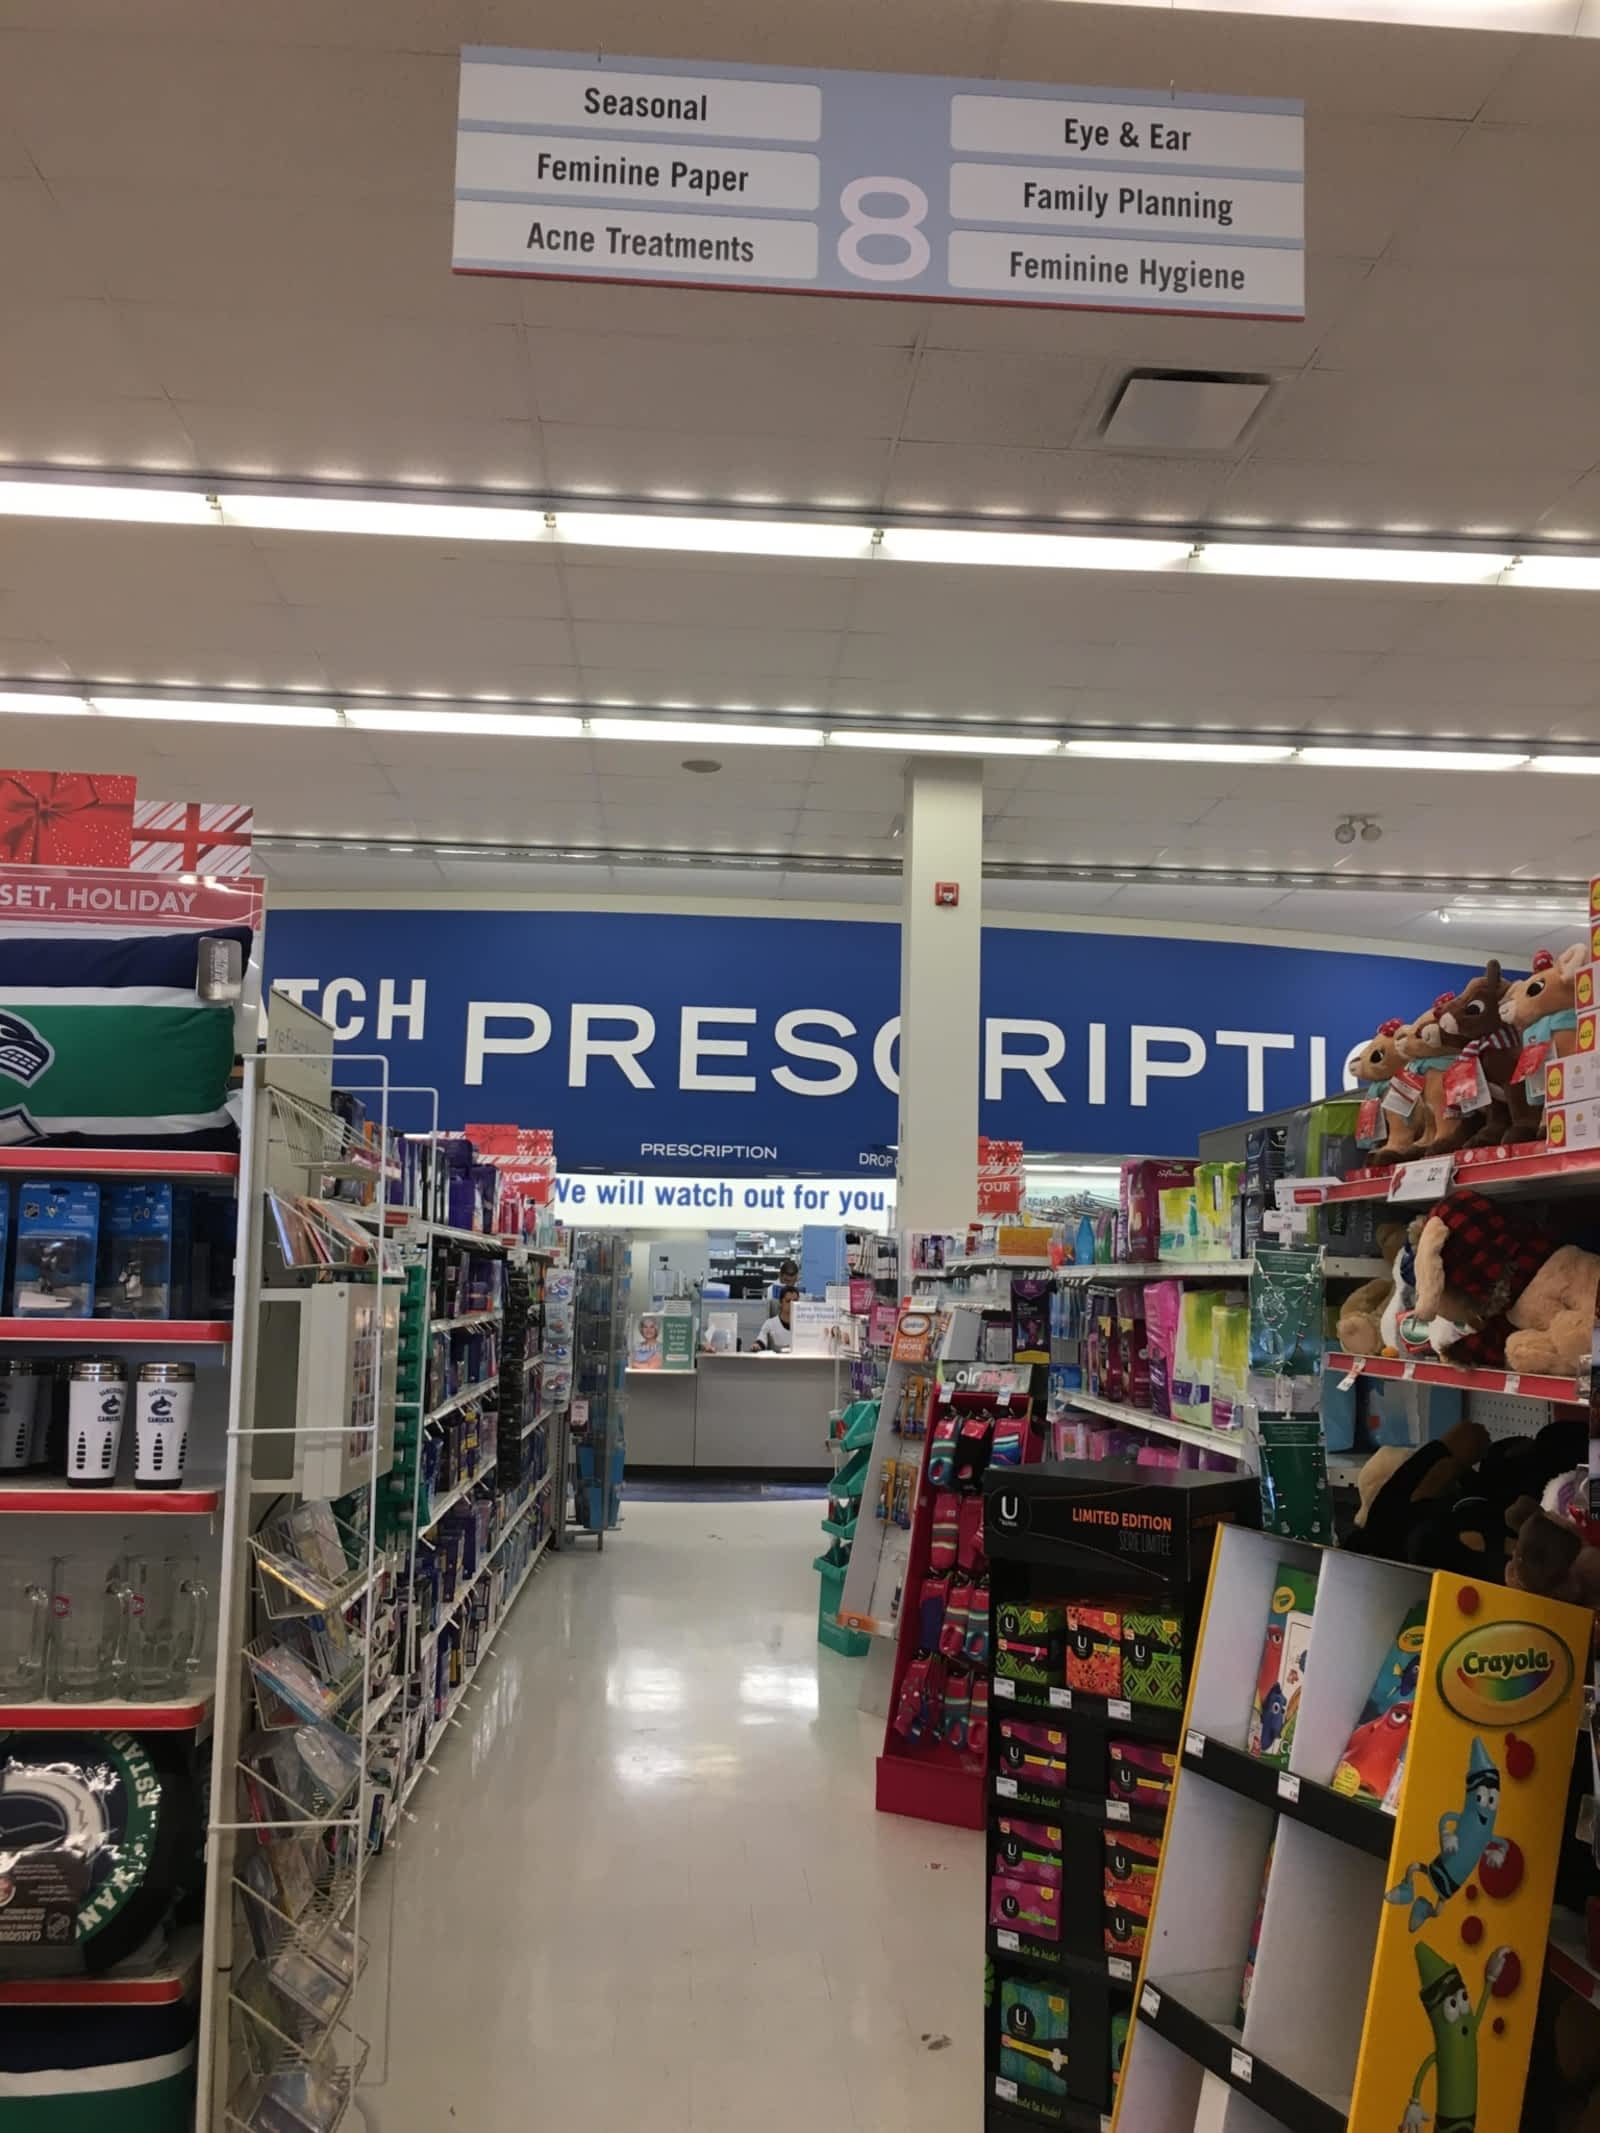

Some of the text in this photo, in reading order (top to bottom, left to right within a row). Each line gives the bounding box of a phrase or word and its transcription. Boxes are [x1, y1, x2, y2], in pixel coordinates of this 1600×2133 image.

[583, 88, 709, 123] Seasonal
[1064, 118, 1193, 153] Eye & Ear
[536, 153, 750, 199] Feminine Paper
[1023, 182, 1234, 228] Family Planning
[526, 222, 755, 264] Acne Treatments
[837, 175, 932, 282] 8
[1009, 251, 1246, 294] Feminine Hygiene
[0, 884, 198, 913] SET, HOLIDAY
[257, 977, 427, 1041] TCH
[463, 1001, 1371, 1113] PRESRIPTI
[640, 1143, 777, 1159] PRESCRIPTION
[859, 1153, 893, 1167] DROP
[596, 1179, 644, 1205] will
[655, 1182, 733, 1208] watch
[743, 1184, 785, 1209] out
[793, 1184, 830, 1210] for
[838, 1189, 885, 1215] you
[1001, 1495, 1018, 1521] U
[1072, 1507, 1120, 1527] LIMITED
[1122, 1512, 1173, 1532] EDITION
[1462, 1648, 1550, 1677] Crayola
